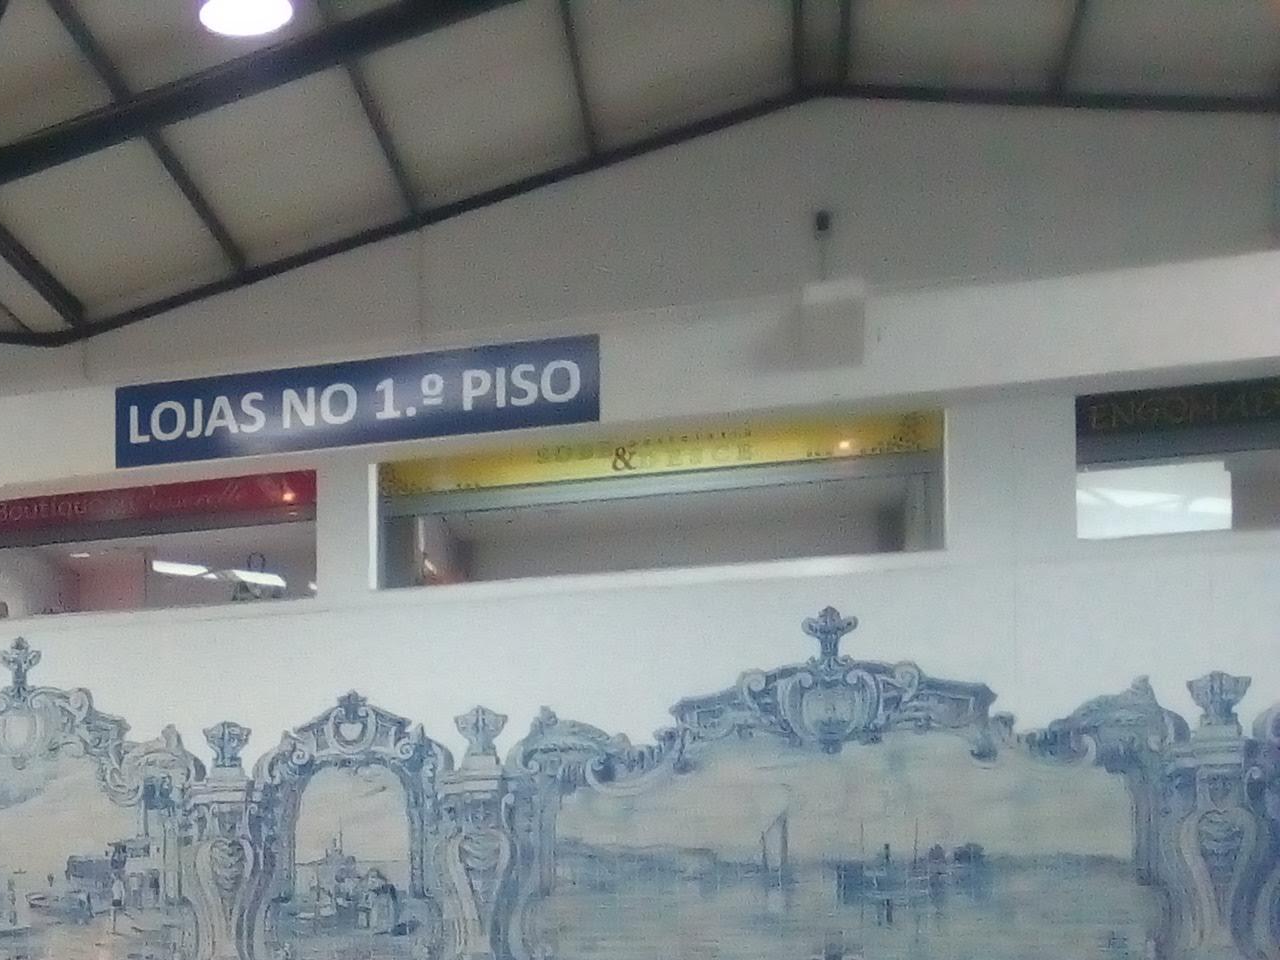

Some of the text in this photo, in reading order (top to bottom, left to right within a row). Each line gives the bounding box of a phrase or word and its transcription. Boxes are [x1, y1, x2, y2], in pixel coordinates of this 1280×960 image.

[128, 359, 581, 444] LOJAS NO 1.º PISO
[612, 445, 637, 471] &
